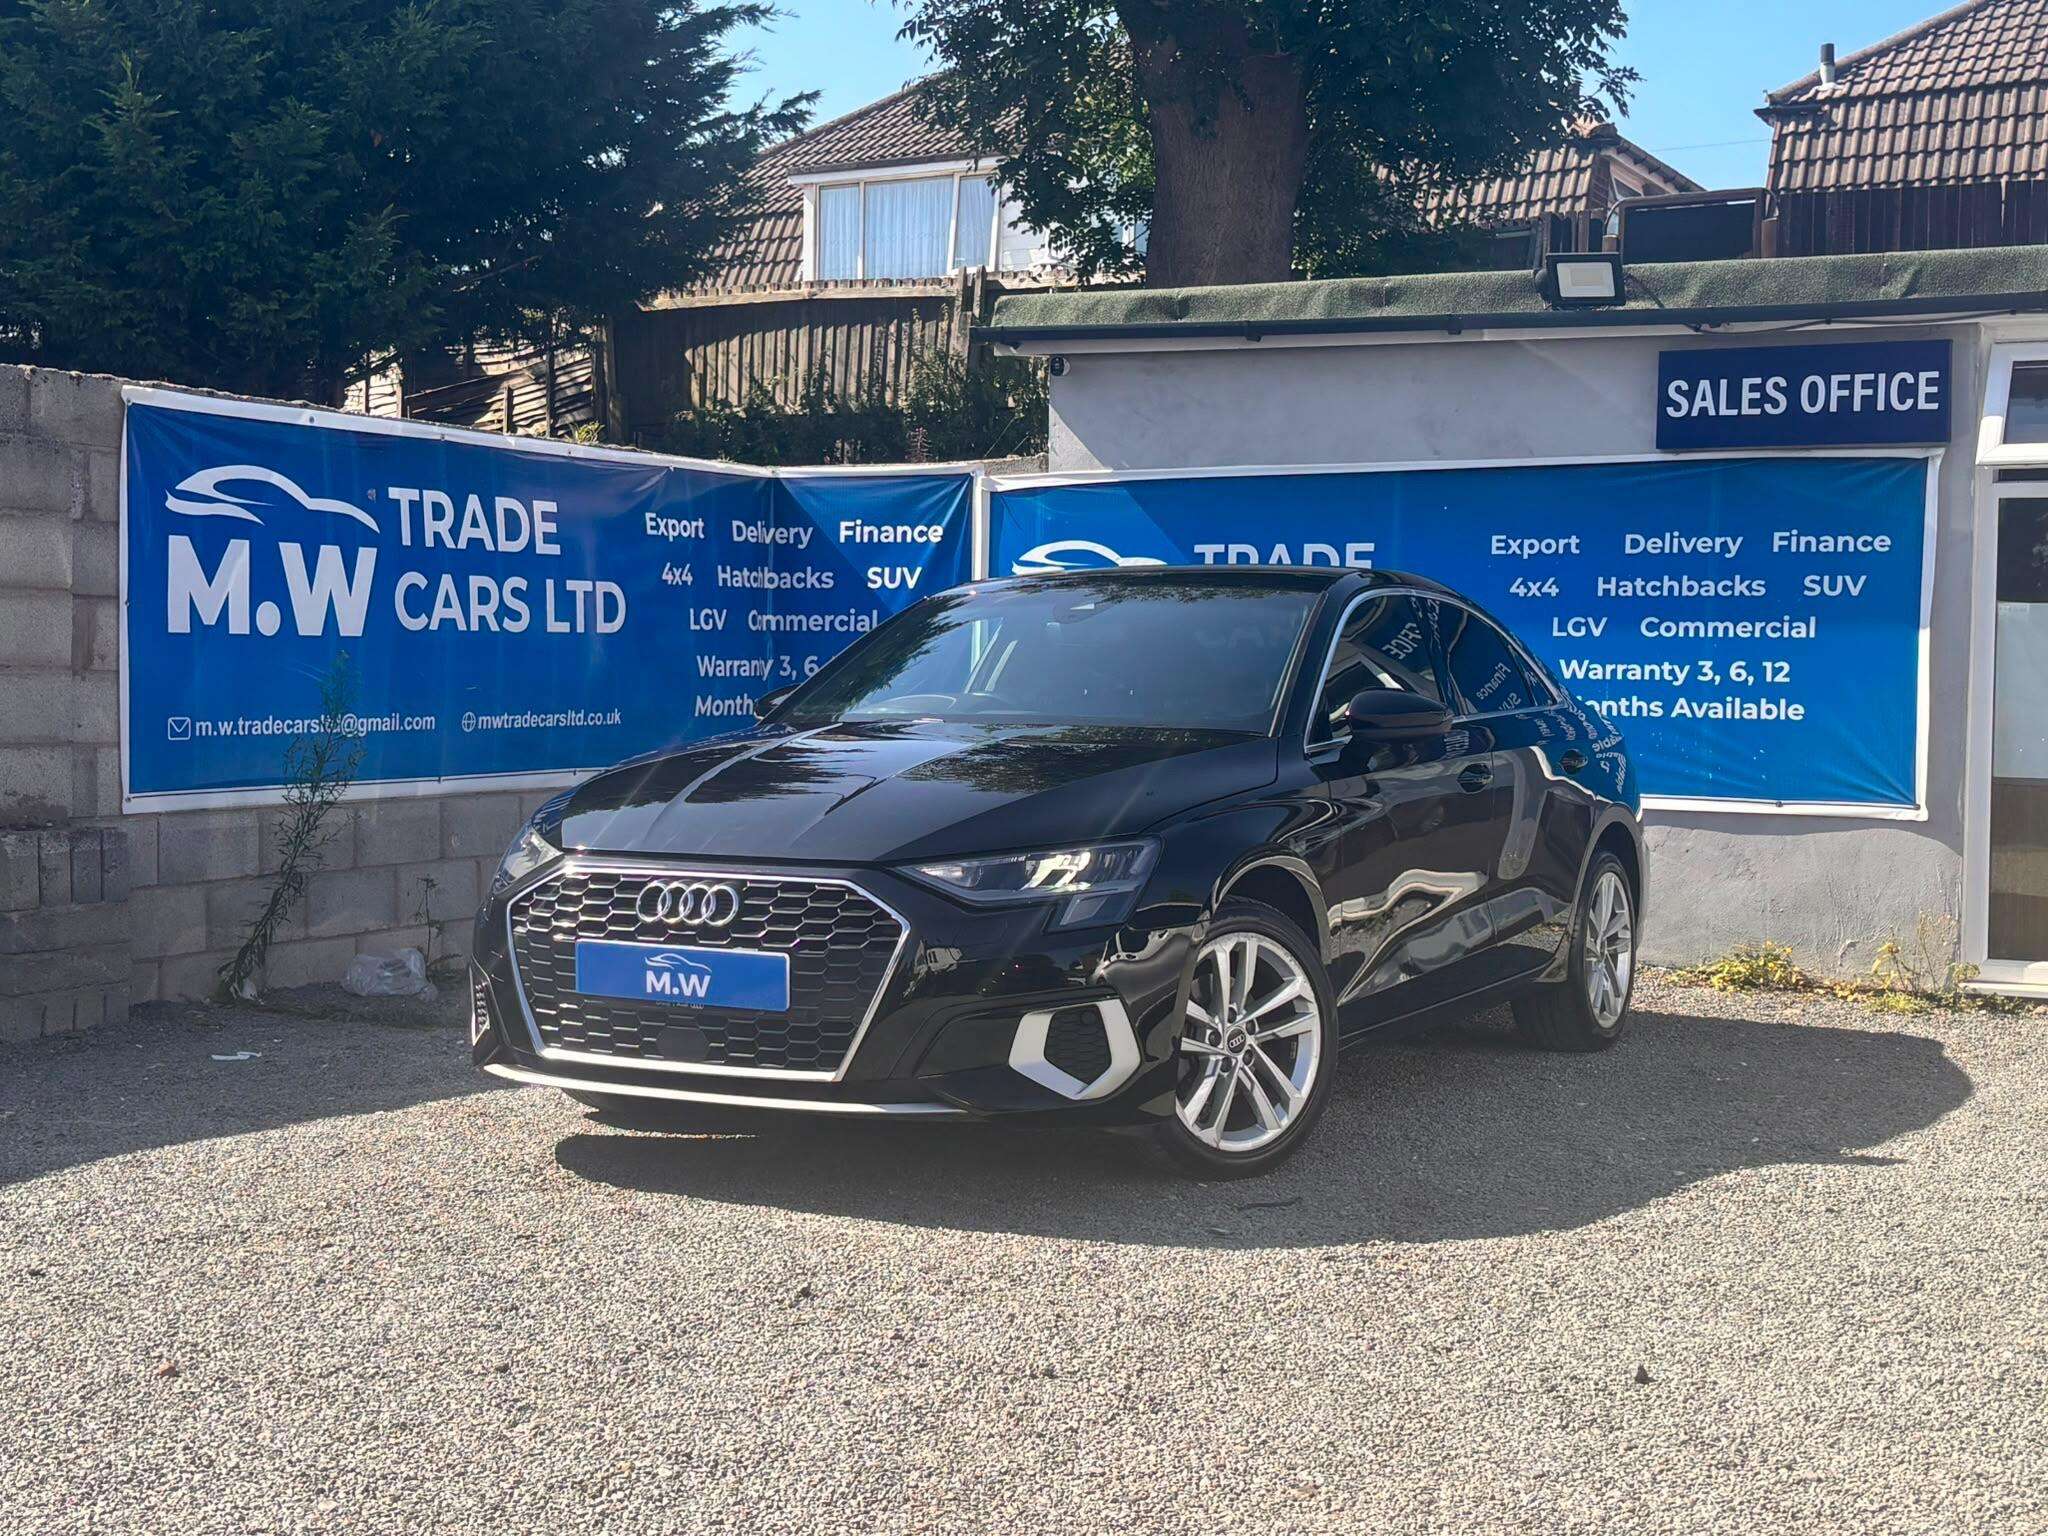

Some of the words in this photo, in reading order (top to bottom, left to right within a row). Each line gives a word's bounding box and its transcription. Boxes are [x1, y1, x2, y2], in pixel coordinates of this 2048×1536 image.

[1666, 376, 1788, 417] SALES
[1800, 371, 1940, 413] OFFICE
[389, 487, 562, 555] TRADE
[645, 512, 705, 540] Export
[731, 520, 813, 549] Delivery
[839, 521, 944, 544] Finance
[1490, 534, 1581, 560] Export
[1624, 532, 1743, 559] Delivery
[1772, 530, 1892, 553] Finance
[167, 535, 378, 637] M.W
[661, 563, 693, 586] 4x4
[717, 565, 834, 589] Hatchbacks
[866, 566, 922, 590] SUV
[1509, 577, 1560, 597] 4x4
[1596, 575, 1766, 597] Hatchbacks
[1803, 575, 1867, 597] SUV
[394, 571, 531, 632] CARS
[546, 579, 627, 634] LTD
[689, 609, 727, 631] LGV
[1551, 617, 1608, 637] LGV
[1639, 615, 1817, 639] Commercial
[779, 655, 797, 680] 3,
[1558, 659, 1690, 685] Warranty
[1696, 660, 1722, 684] 3,
[1729, 661, 1754, 686] 6,
[1762, 661, 1791, 682] 12
[694, 694, 758, 716] Month
[1576, 696, 1663, 718] onths
[1671, 697, 1805, 721] Available
[477, 708, 622, 730] mwtradecarsltd.co.uk
[646, 970, 710, 997] M.W
